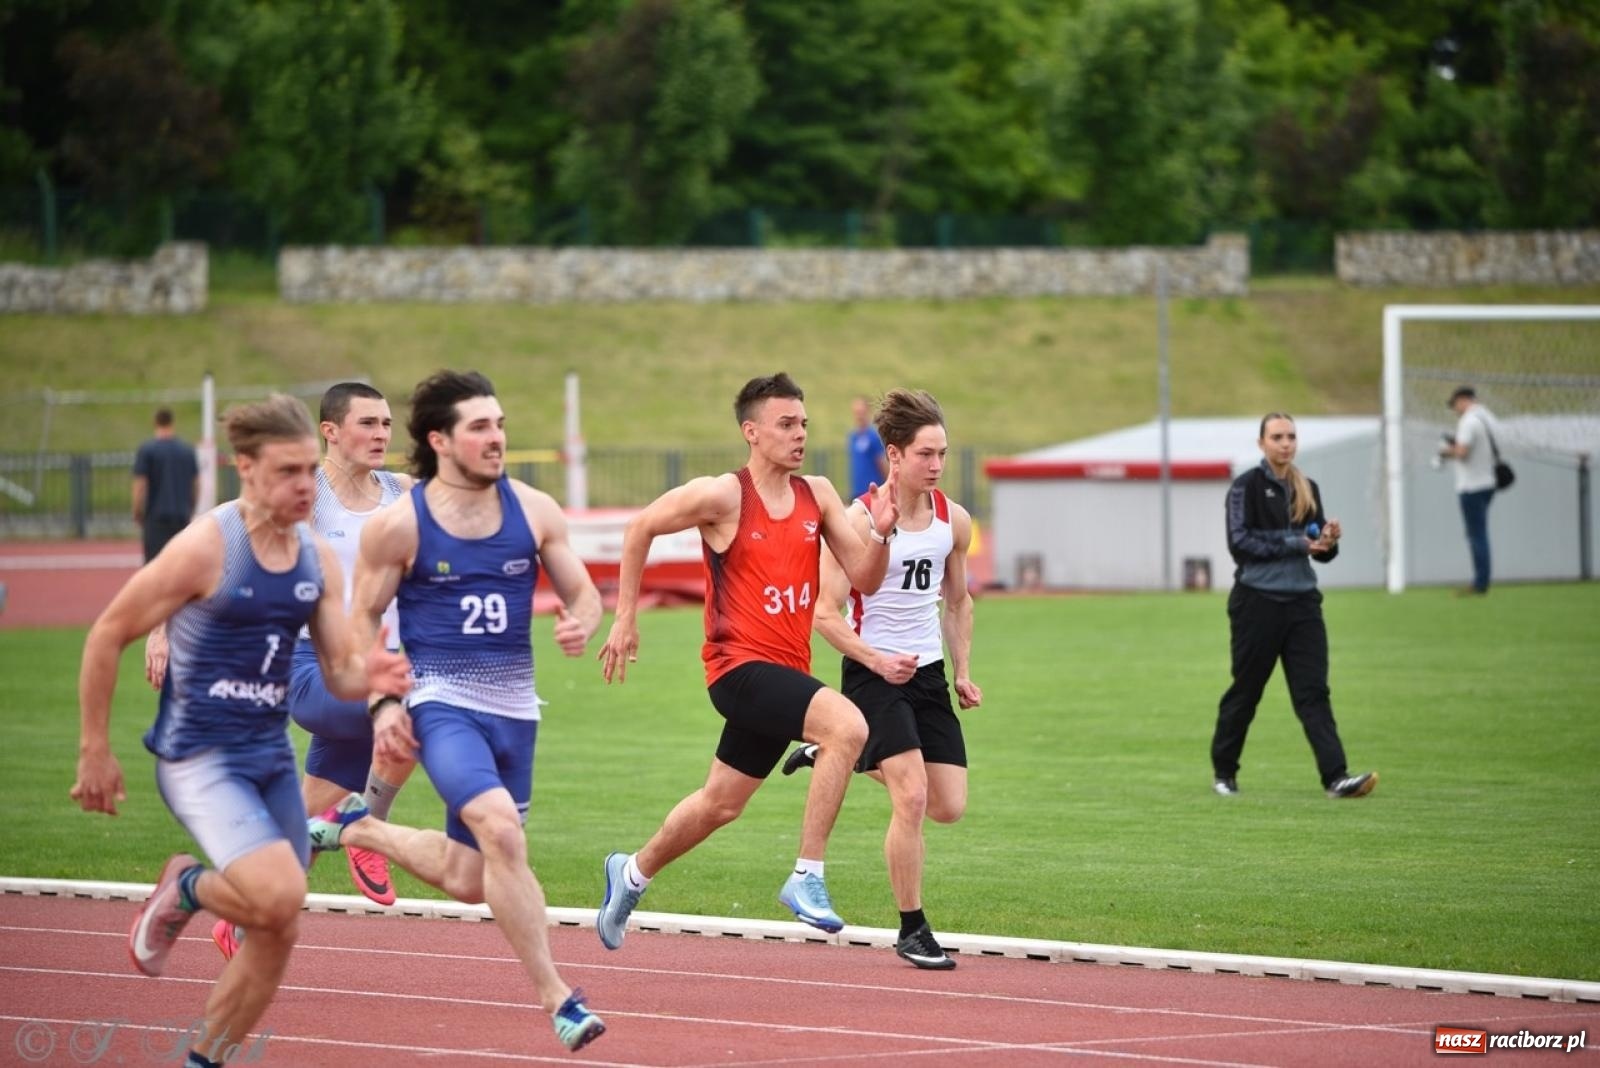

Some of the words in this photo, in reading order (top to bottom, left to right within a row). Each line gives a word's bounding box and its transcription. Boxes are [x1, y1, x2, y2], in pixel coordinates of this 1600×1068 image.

[901, 558, 932, 590] 76
[460, 593, 508, 634] 29
[763, 582, 811, 615] 314
